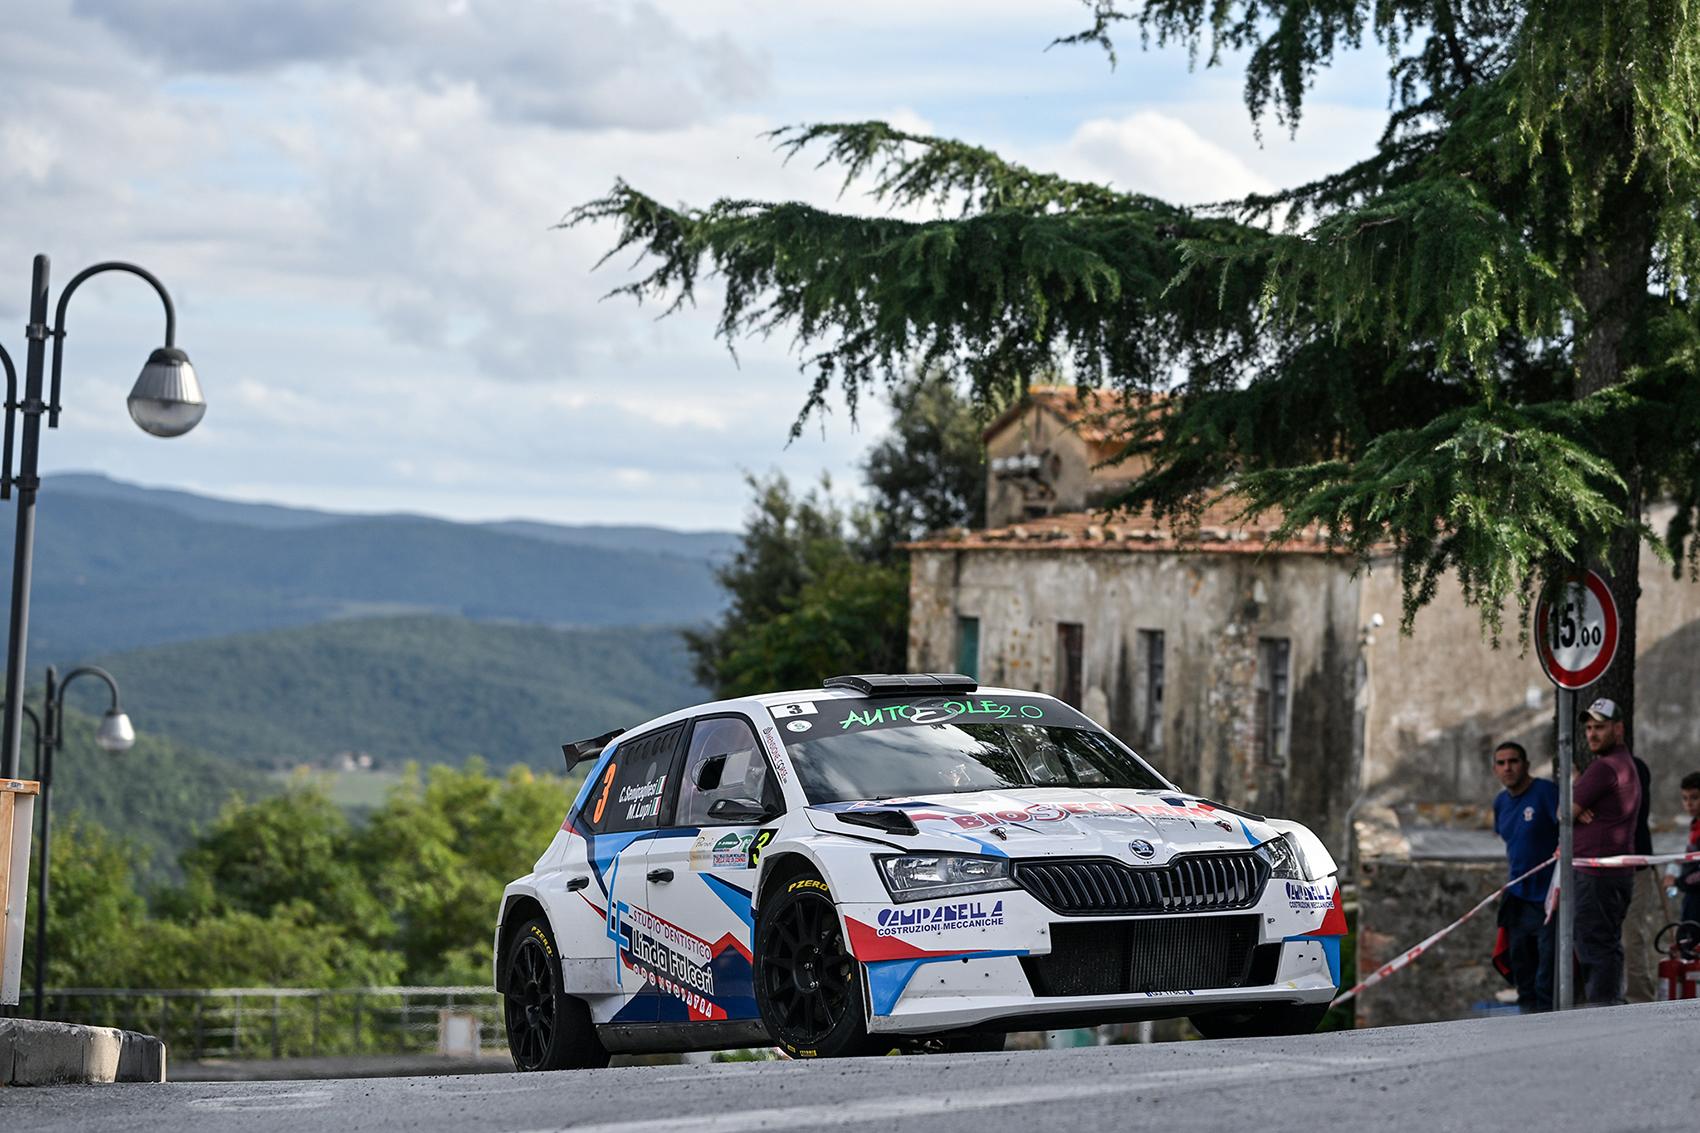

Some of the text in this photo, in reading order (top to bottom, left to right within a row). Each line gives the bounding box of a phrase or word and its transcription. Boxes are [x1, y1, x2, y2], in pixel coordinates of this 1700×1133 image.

[1551, 603, 1602, 650] 15.00
[786, 704, 803, 715] 3
[593, 763, 617, 824] 3
[752, 832, 770, 865] 3
[877, 900, 1004, 927] CAMPANELLA
[878, 917, 1004, 936] COSTRUZIONI MECCANICHE
[632, 909, 712, 962] STUDIO DENTISTICO
[632, 927, 716, 997] Linda Fulceri
